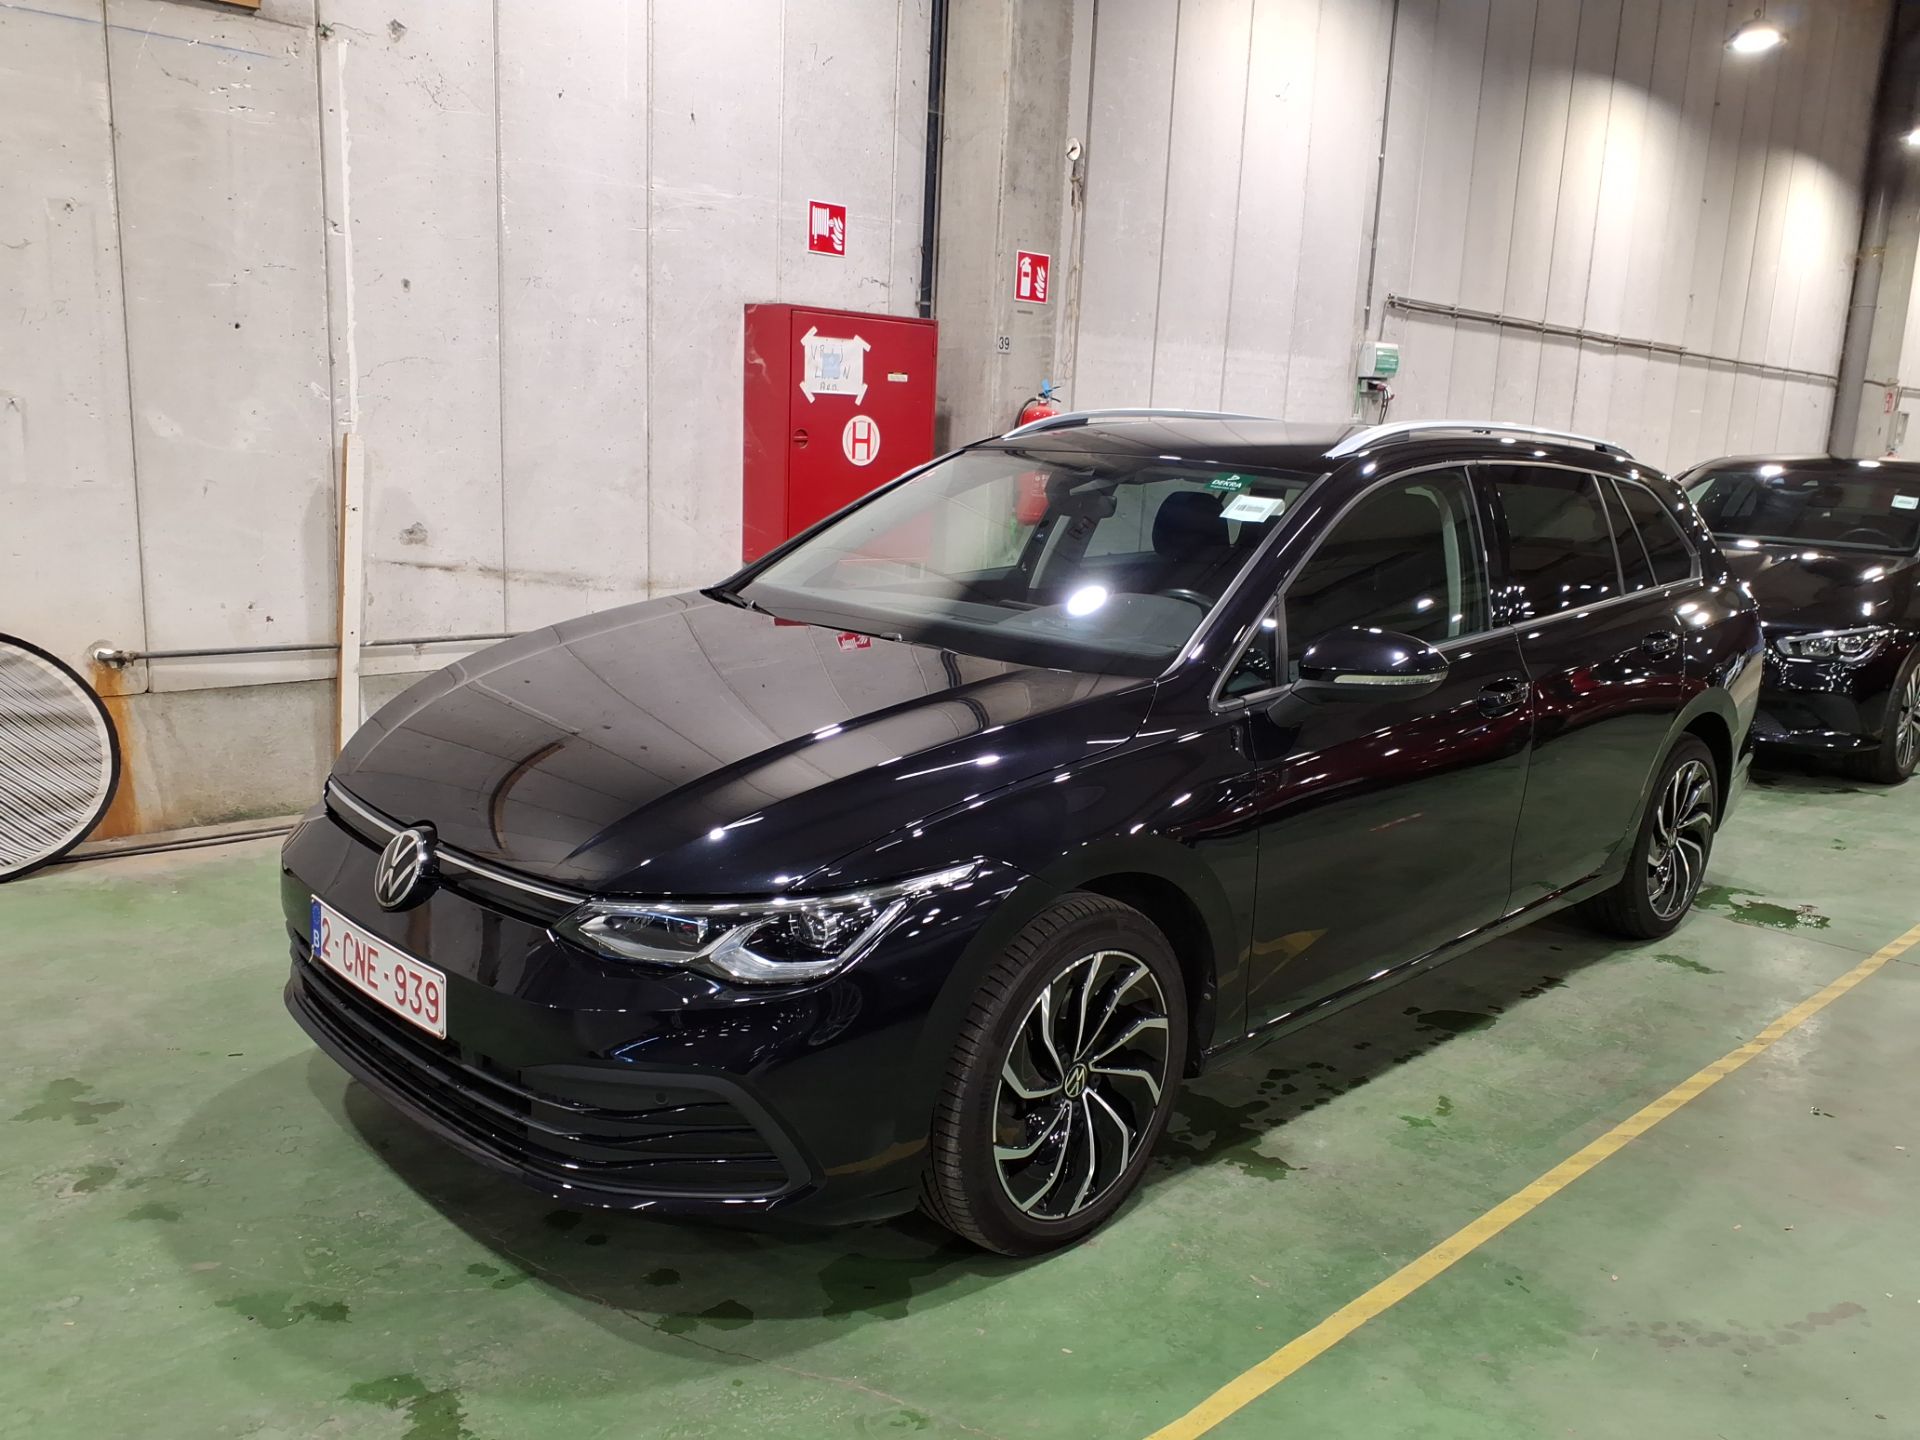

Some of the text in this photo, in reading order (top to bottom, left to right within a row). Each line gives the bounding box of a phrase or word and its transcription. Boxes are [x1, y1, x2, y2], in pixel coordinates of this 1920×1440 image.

[999, 336, 1010, 350] 39
[853, 421, 872, 460] H
[1212, 479, 1242, 489] DEKRA
[313, 929, 320, 948] B
[322, 917, 439, 1024] 2-CNE-939
